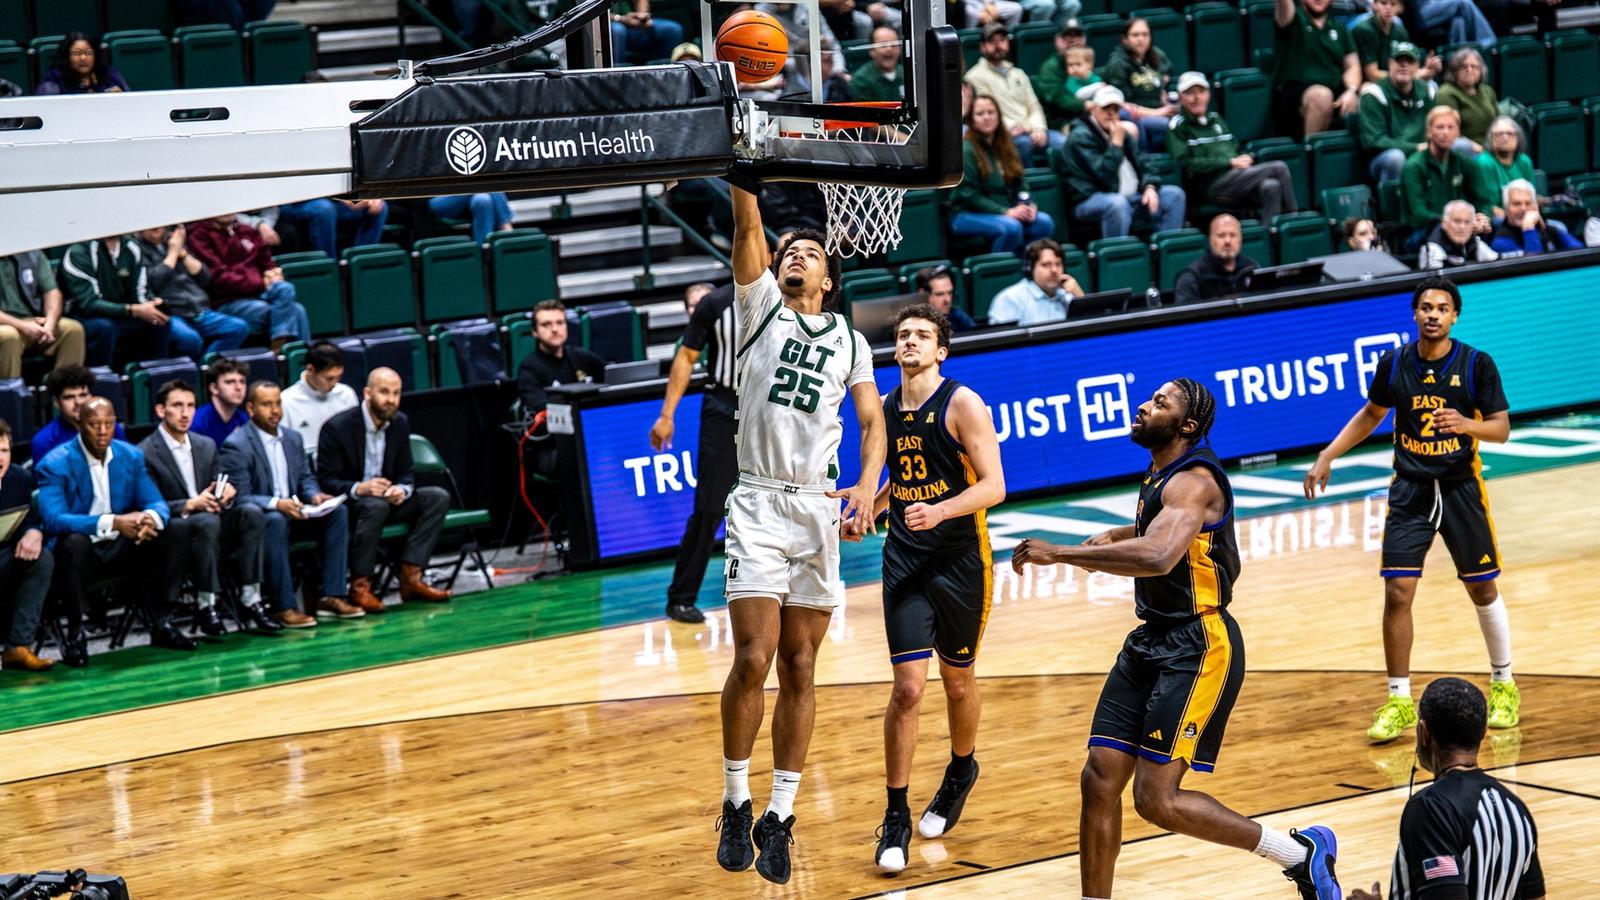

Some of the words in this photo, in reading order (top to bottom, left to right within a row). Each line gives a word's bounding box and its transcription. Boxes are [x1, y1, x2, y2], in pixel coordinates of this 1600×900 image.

[738, 55, 776, 71] ELITE
[494, 136, 577, 162] Atrium
[579, 128, 655, 157] Health
[779, 337, 836, 374] CLT
[767, 366, 825, 415] 25
[1214, 352, 1349, 407] TRUIST
[1411, 394, 1447, 411] EAST
[985, 393, 1072, 443] UIST
[1420, 412, 1435, 437] 2
[896, 435, 924, 453] EAST
[1401, 433, 1461, 456] CAROLINA
[623, 450, 698, 497] TRU
[900, 454, 928, 481] 33
[891, 479, 950, 502] CAROLINA
